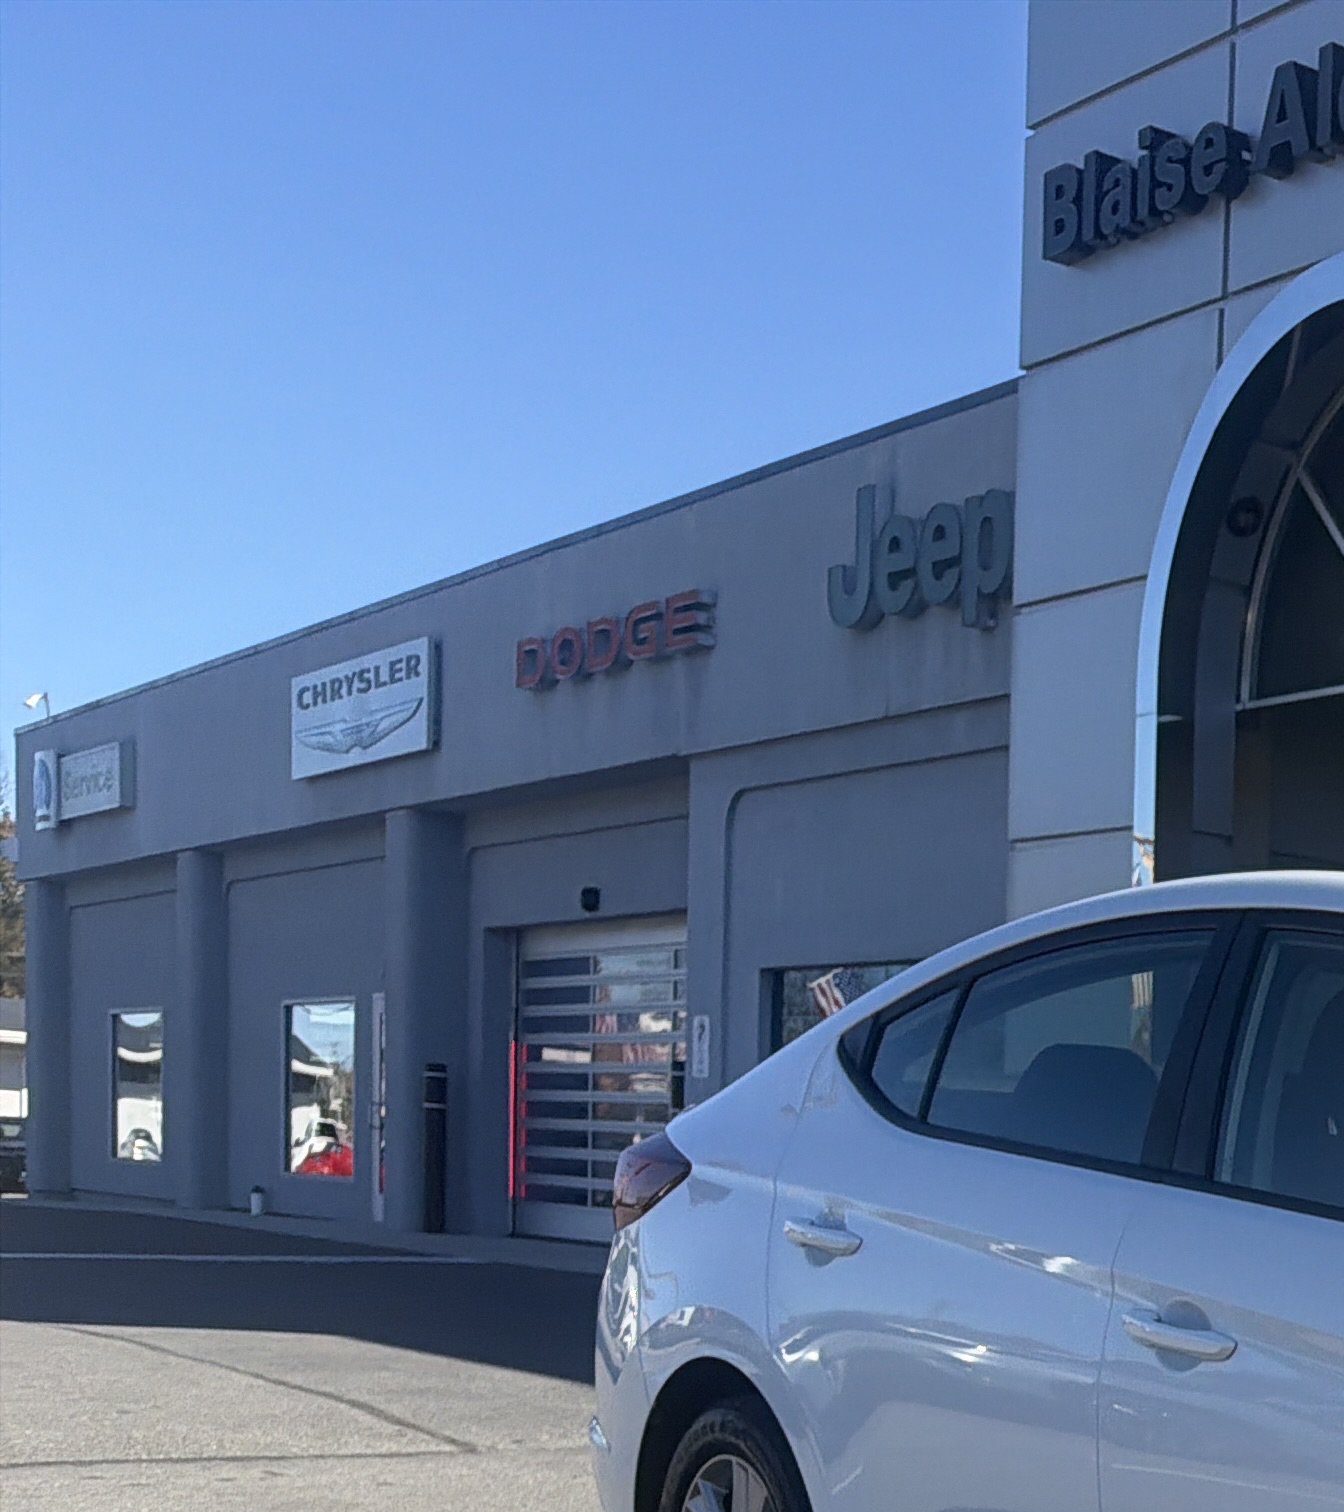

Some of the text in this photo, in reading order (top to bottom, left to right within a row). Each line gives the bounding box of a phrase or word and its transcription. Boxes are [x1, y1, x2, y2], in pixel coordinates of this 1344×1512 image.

[1042, 121, 1246, 264] Blaise
[828, 484, 1015, 631] Jeep
[296, 653, 422, 711] CHRYSLER
[515, 588, 712, 689] DODGE
